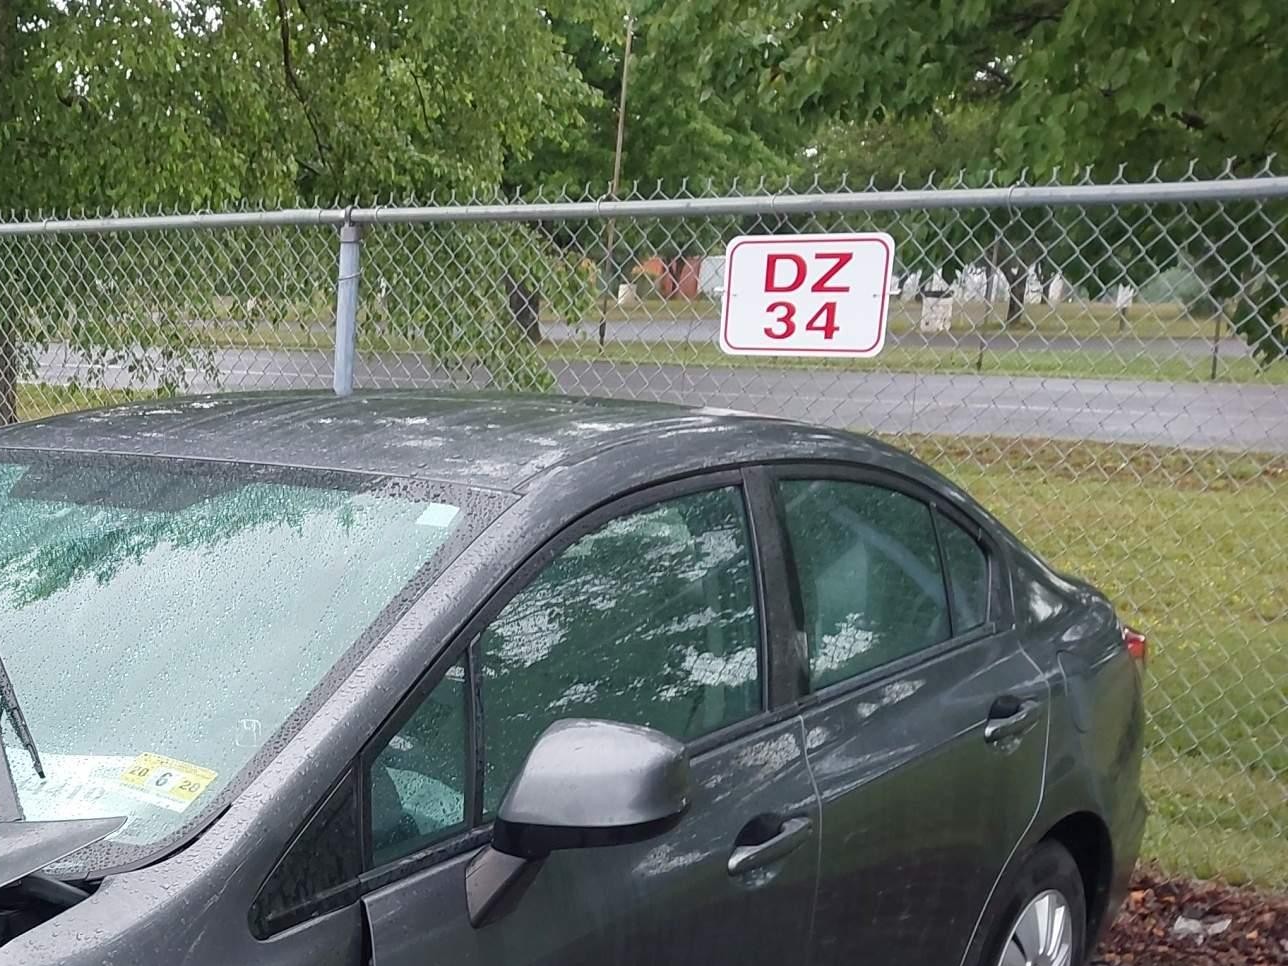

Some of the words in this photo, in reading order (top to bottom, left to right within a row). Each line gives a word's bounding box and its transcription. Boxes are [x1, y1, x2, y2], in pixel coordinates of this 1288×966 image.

[764, 252, 854, 293] DZ
[763, 301, 840, 340] 34
[155, 772, 173, 787] 6
